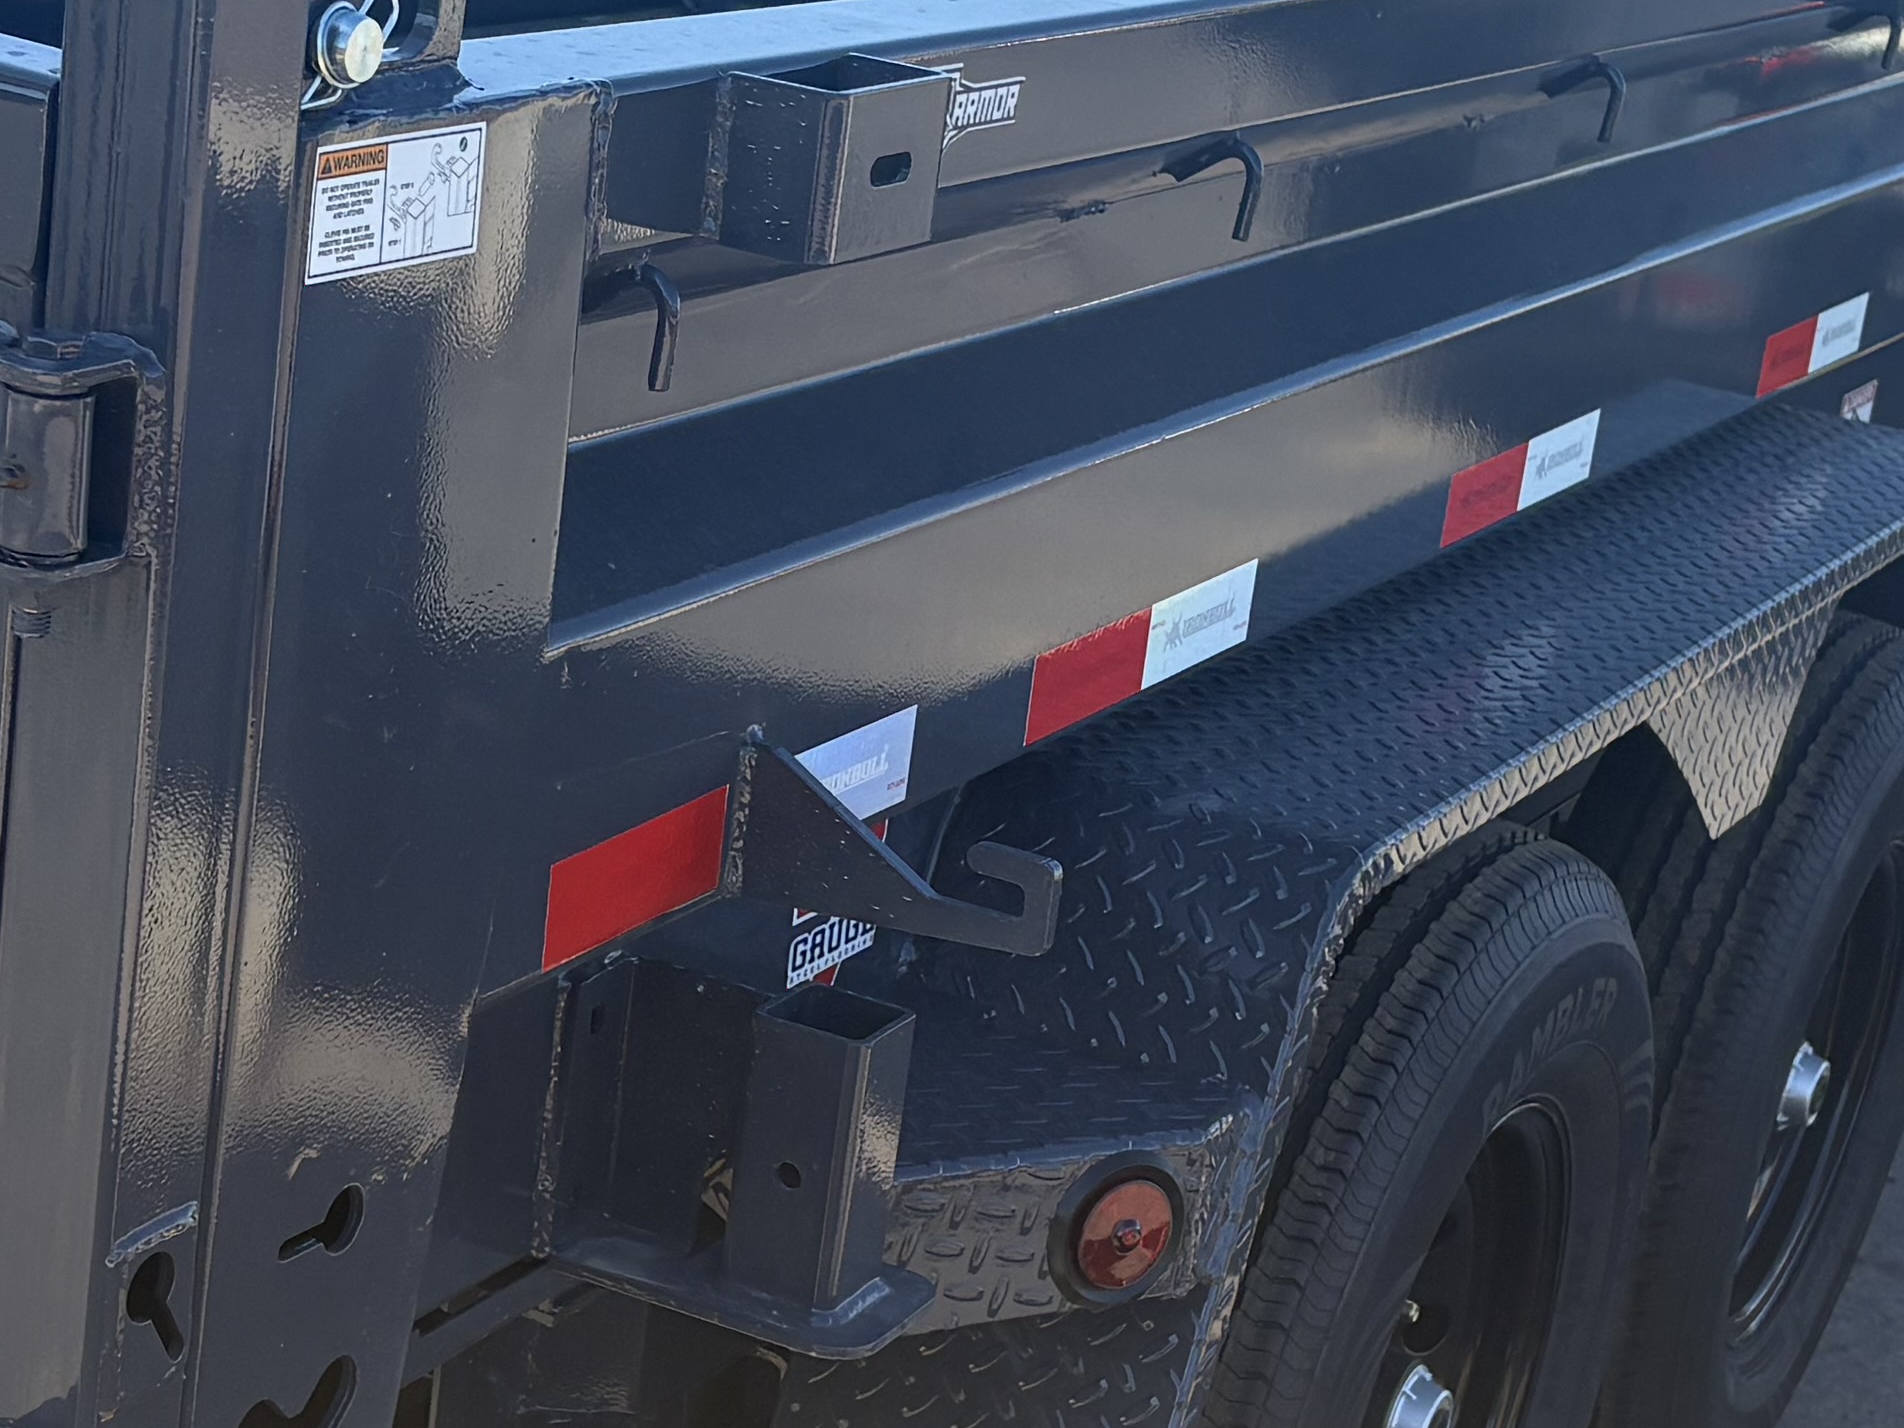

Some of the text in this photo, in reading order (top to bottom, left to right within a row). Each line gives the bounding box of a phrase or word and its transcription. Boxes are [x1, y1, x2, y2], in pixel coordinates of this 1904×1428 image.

[952, 84, 1021, 127] ARMOR
[332, 149, 385, 172] WARNING
[1482, 976, 1618, 1139] RAMBLER
